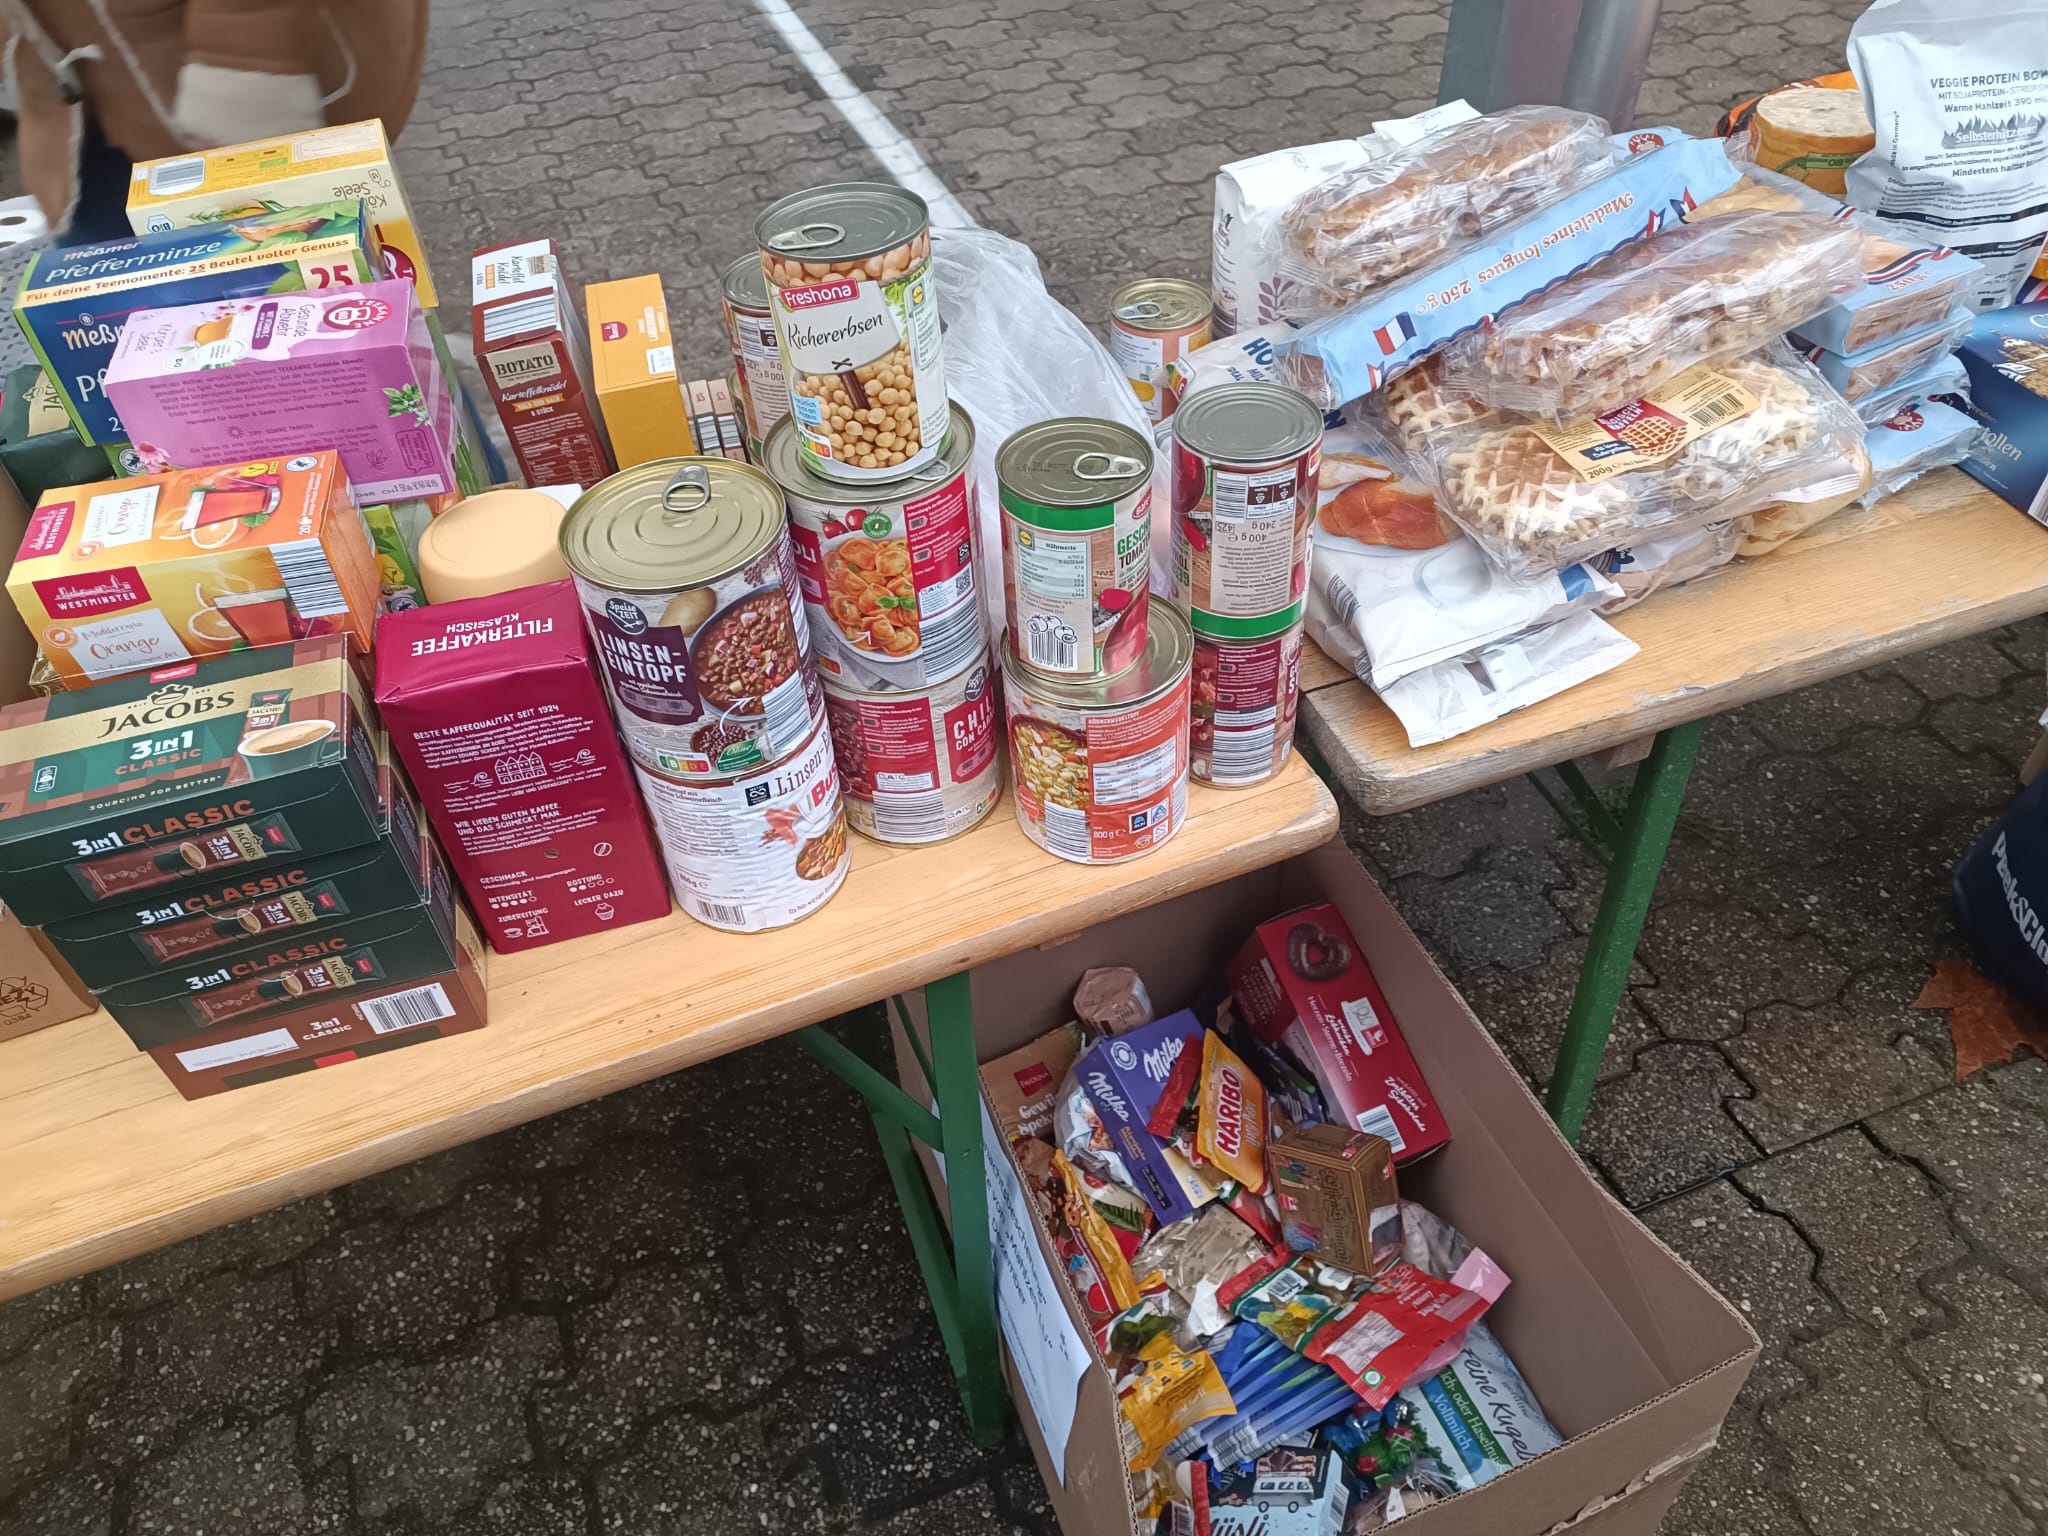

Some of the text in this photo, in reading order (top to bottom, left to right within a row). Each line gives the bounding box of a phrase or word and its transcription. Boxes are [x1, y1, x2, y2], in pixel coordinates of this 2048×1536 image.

[1930, 77, 1969, 88] VEGGIE
[1971, 72, 2020, 86] PROTEIN
[1938, 91, 1952, 100] MIT
[1944, 103, 1973, 113] Warme
[1975, 100, 2012, 110] Mahlzeit
[1952, 164, 1999, 177] Mindestens
[332, 181, 371, 197] Seele
[1542, 190, 1635, 250] Madeleines
[26, 238, 349, 302] Für deine Teemomente: 25 Beutel voller Genuss
[45, 240, 222, 283] Pfefferminze
[1477, 243, 1542, 285] longues
[310, 264, 353, 290] 25
[785, 284, 852, 307] Freshona
[1439, 278, 1472, 306] 250
[297, 303, 317, 338] Gesunde
[787, 313, 884, 350] Kichererbsen
[494, 354, 554, 376] BOTATO
[501, 379, 568, 402] Kartoffelknödel
[1587, 464, 1613, 480] 200g
[1259, 519, 1277, 531] 240
[1248, 533, 1267, 543] 400
[56, 592, 138, 611] WESTMINSTER
[609, 600, 637, 613] Speise
[446, 612, 520, 634] KLASSISCH
[620, 611, 639, 620] ZEIT
[90, 637, 160, 660] Orange
[410, 617, 553, 657] FILTERKAFFEE
[599, 629, 682, 664] LINSEN-
[605, 649, 687, 684] EINTOPF
[96, 691, 236, 739] JACOBS
[413, 704, 559, 740] BESTE KAFFEEQUALITÄT SEIT 1924
[956, 733, 975, 751] CON
[114, 747, 202, 776] CLASSIC
[88, 792, 146, 811] SOURCING
[150, 786, 171, 796] FOR
[123, 799, 256, 843] CLASSIC
[457, 828, 475, 837] UND
[477, 824, 494, 833] DAS
[471, 815, 499, 827] LIEBEN
[501, 809, 529, 821] GUTEN
[232, 827, 258, 858] JACOBS
[1093, 828, 1108, 839] 800
[480, 870, 528, 885] GESCHMACK
[184, 869, 308, 912] CLASSIC
[574, 888, 624, 907] LECKER DAZU
[285, 894, 311, 922] JACOBS
[497, 907, 549, 924] ZUBEREITUNG
[231, 937, 349, 976] CLASSIC
[325, 958, 350, 987] JACOBS
[302, 1024, 353, 1041] CLASSIC
[1144, 1035, 1185, 1083] Milka
[1088, 1071, 1130, 1123] Milka
[1216, 1067, 1242, 1157] HARIBO
[1453, 1391, 1473, 1416] oder
[1433, 1393, 1474, 1451] Vollmilch
